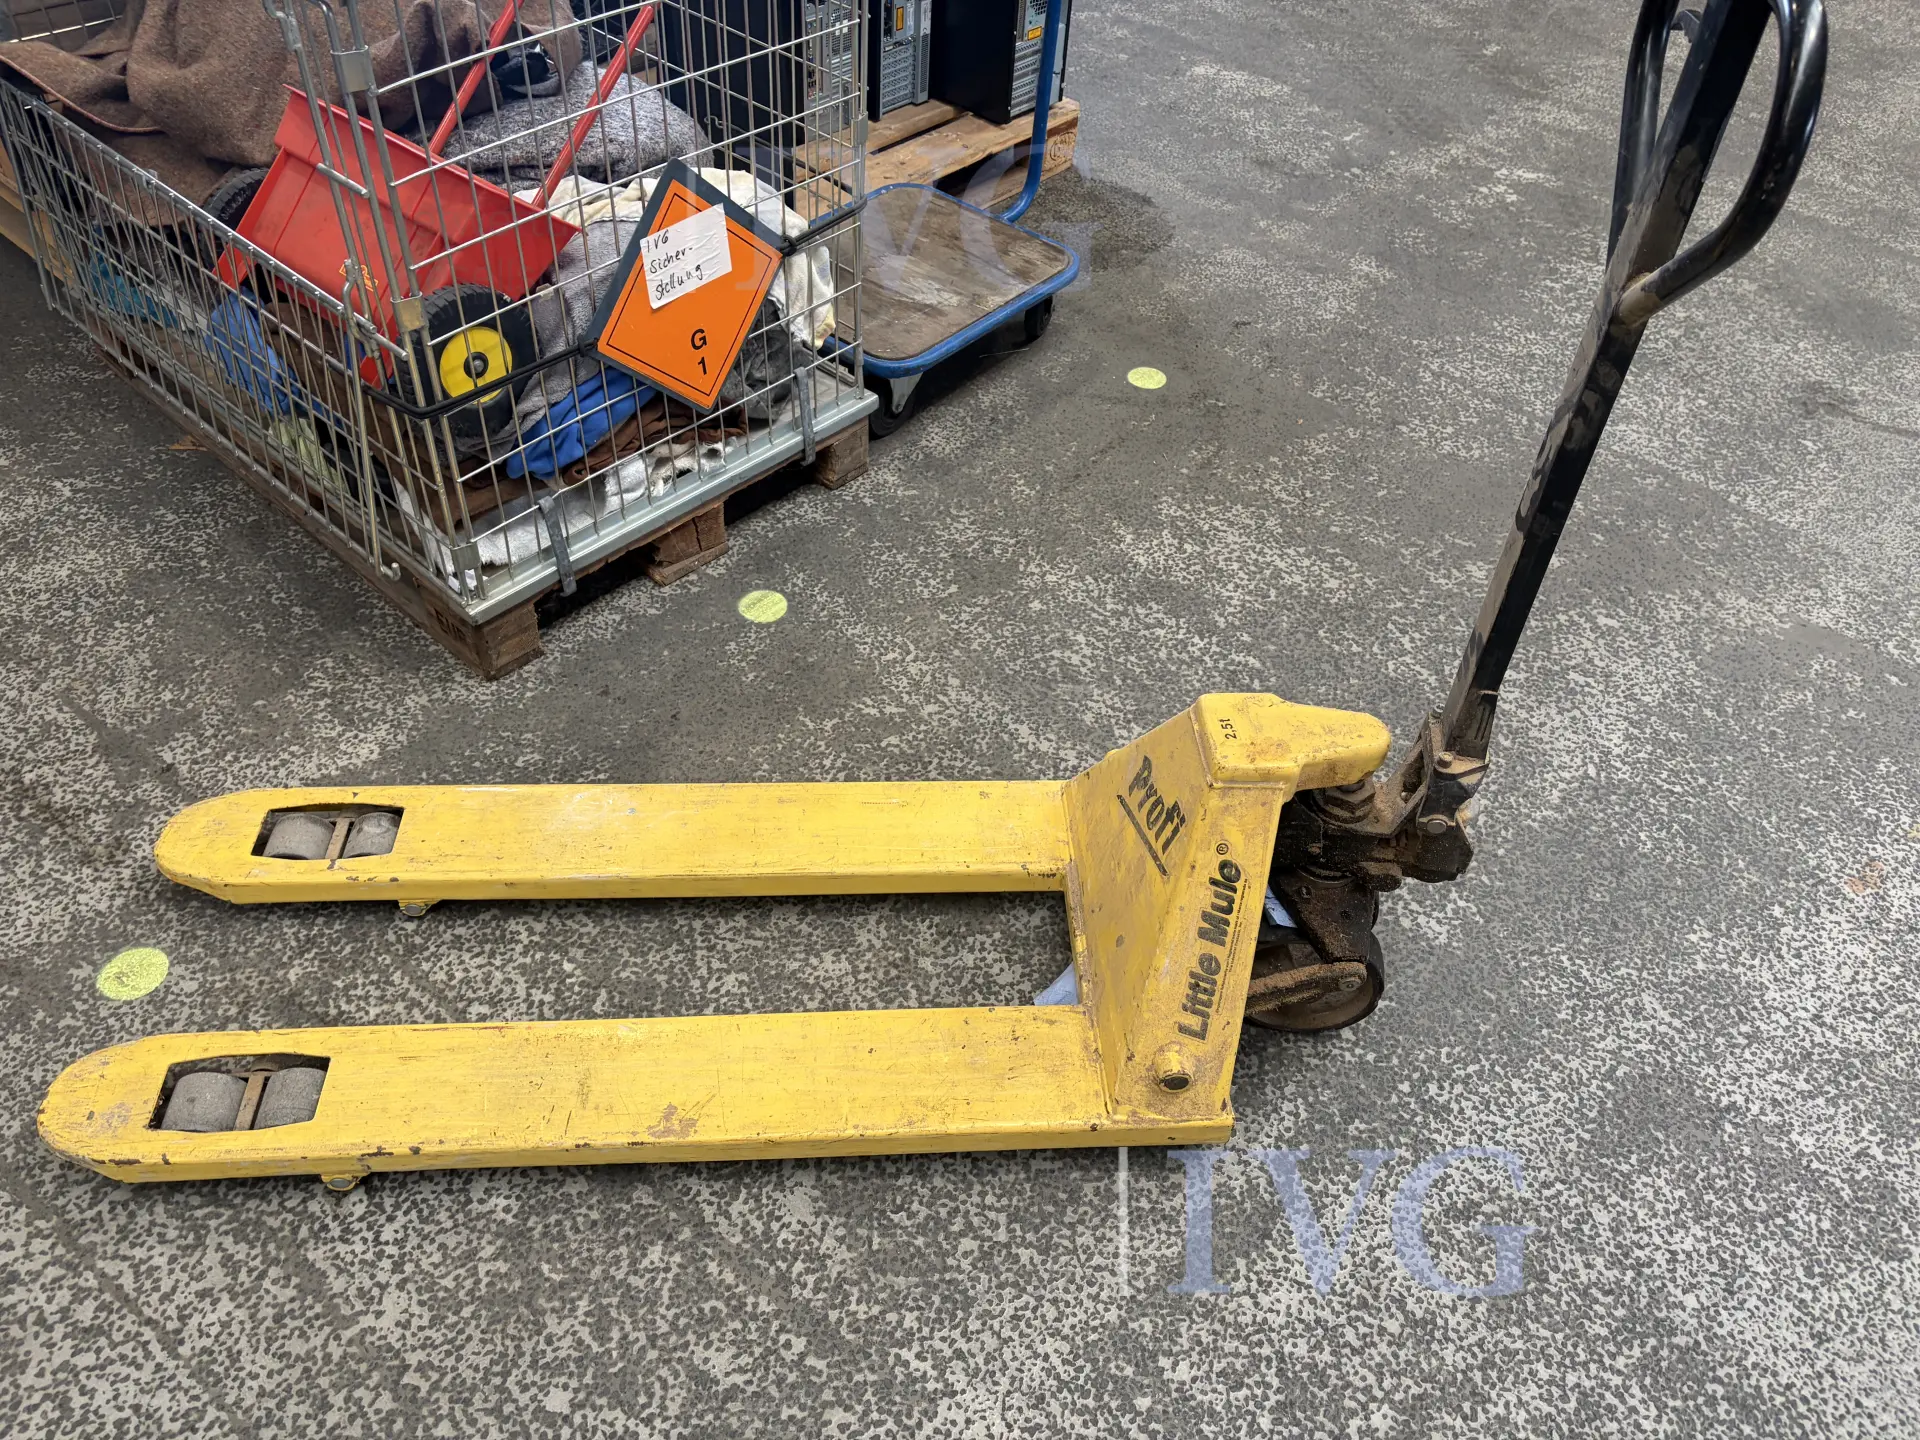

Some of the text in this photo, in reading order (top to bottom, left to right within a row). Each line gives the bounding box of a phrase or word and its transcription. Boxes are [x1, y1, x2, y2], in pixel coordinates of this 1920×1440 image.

[649, 247, 693, 273] Sicher-
[655, 264, 703, 300] Stellung
[690, 328, 708, 351] G
[697, 356, 708, 376] 1
[1128, 755, 1187, 855] Profi
[1178, 950, 1222, 1041] Little
